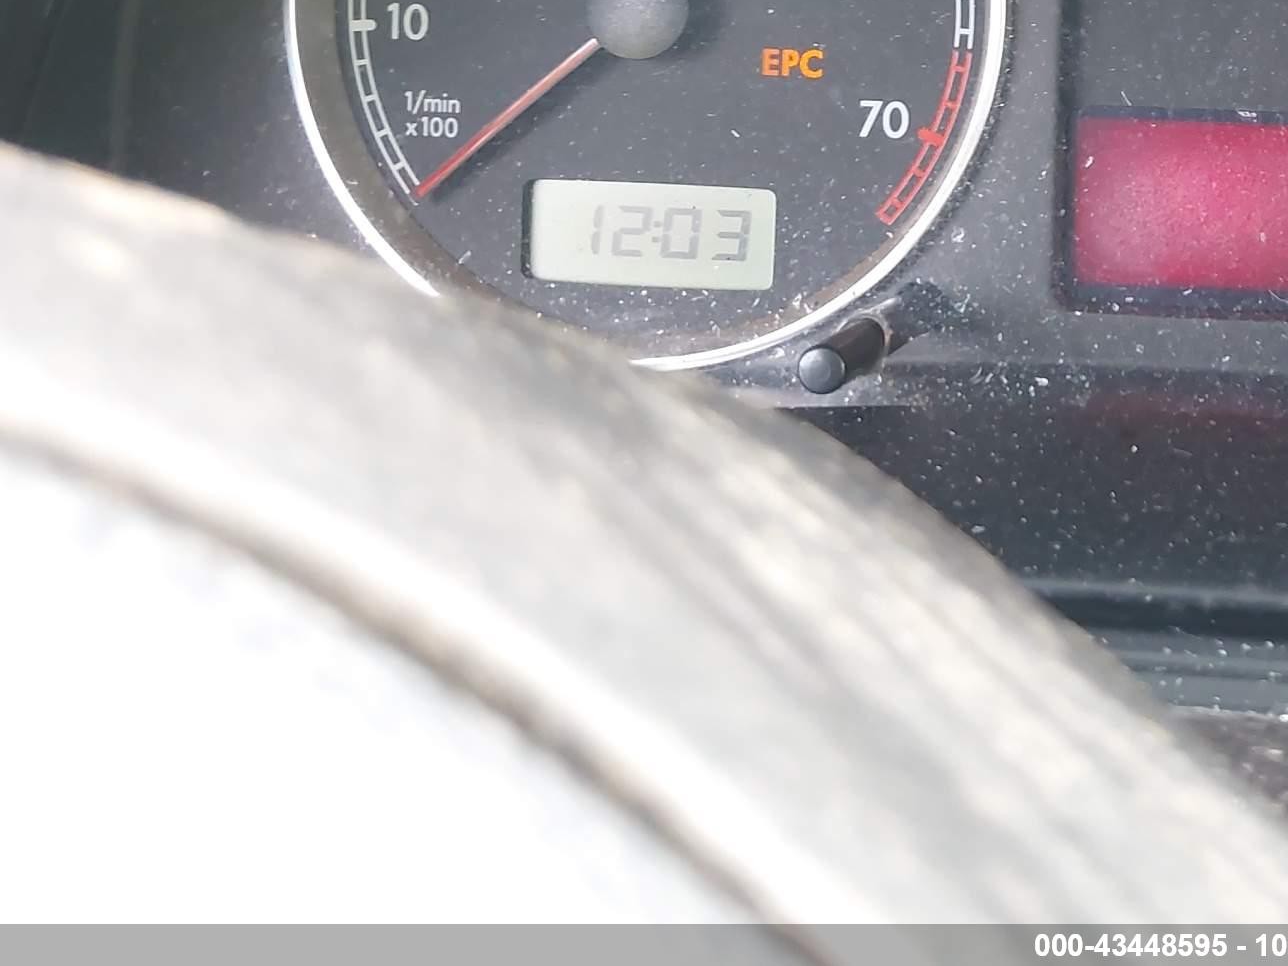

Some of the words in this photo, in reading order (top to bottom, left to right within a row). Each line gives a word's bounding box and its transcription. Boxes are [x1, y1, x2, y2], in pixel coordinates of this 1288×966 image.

[387, 3, 428, 40] 10
[760, 48, 825, 79] EPC
[405, 92, 461, 115] 1/min
[859, 101, 909, 139] 70
[405, 117, 458, 138] x100
[591, 205, 751, 261] 12:03
